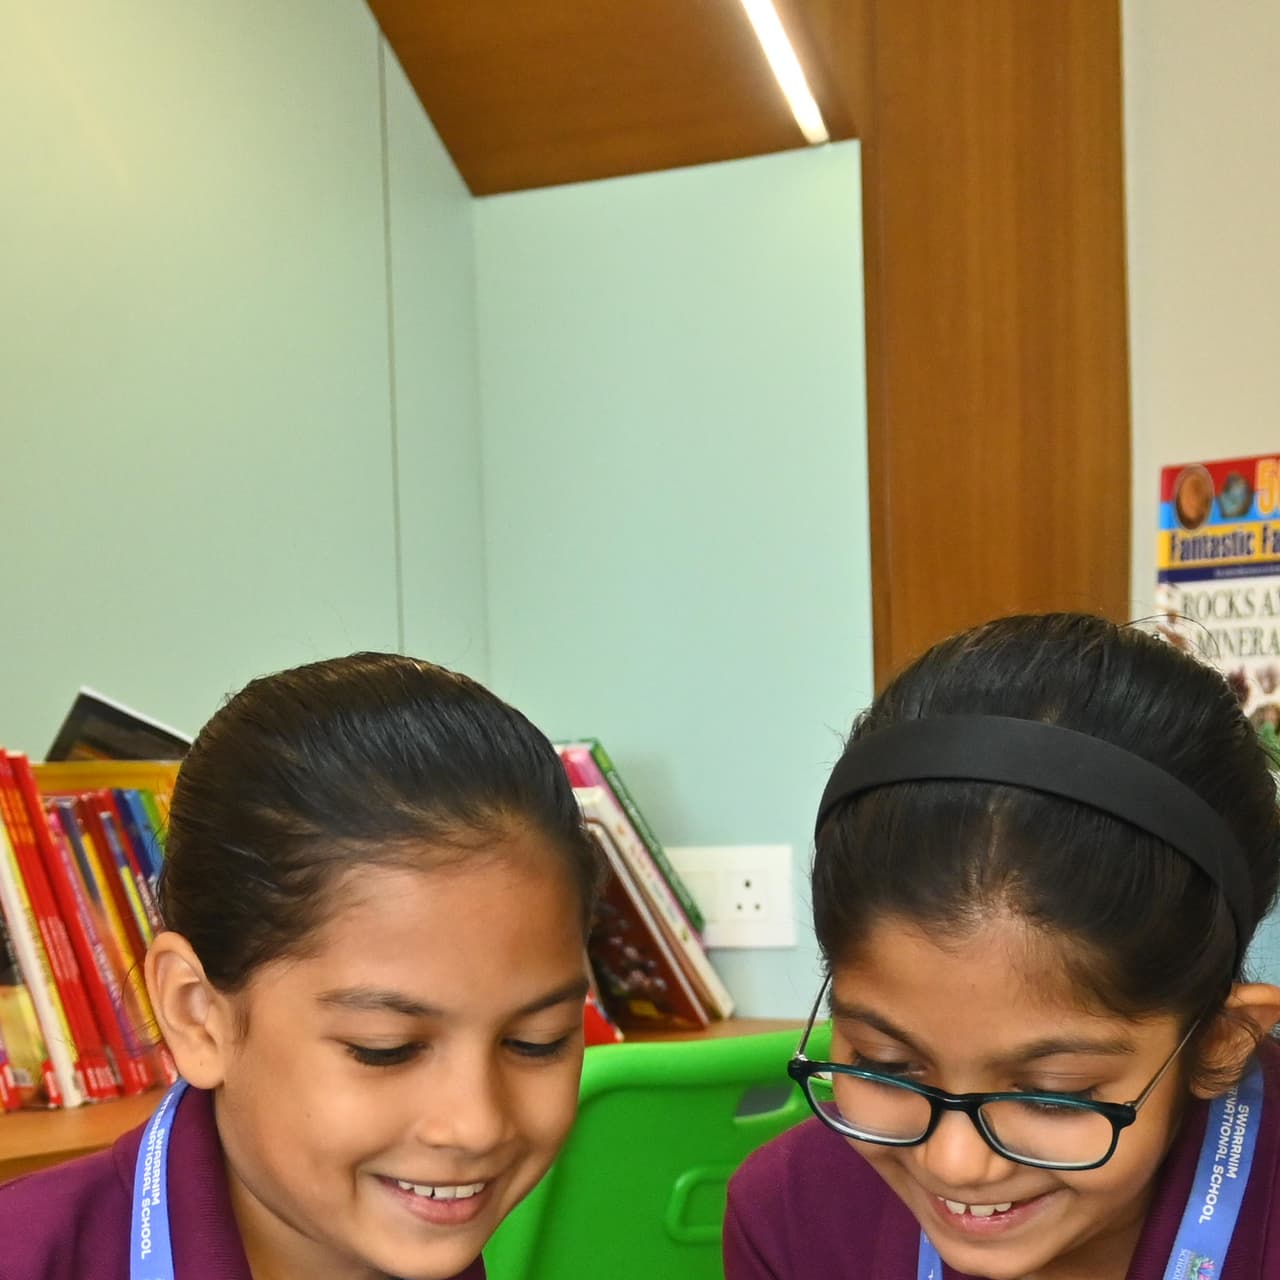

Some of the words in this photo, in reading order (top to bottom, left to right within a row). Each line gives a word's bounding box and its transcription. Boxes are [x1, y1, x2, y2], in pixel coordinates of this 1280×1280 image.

[1170, 530, 1256, 562] Fantastic
[1181, 585, 1256, 620] ROCKS
[151, 1127, 165, 1206] SWARRNIM
[1225, 1104, 1250, 1179] SWARRNIM
[1198, 1164, 1225, 1225] SCHOOL
[141, 1199, 151, 1260] SCHOOL
